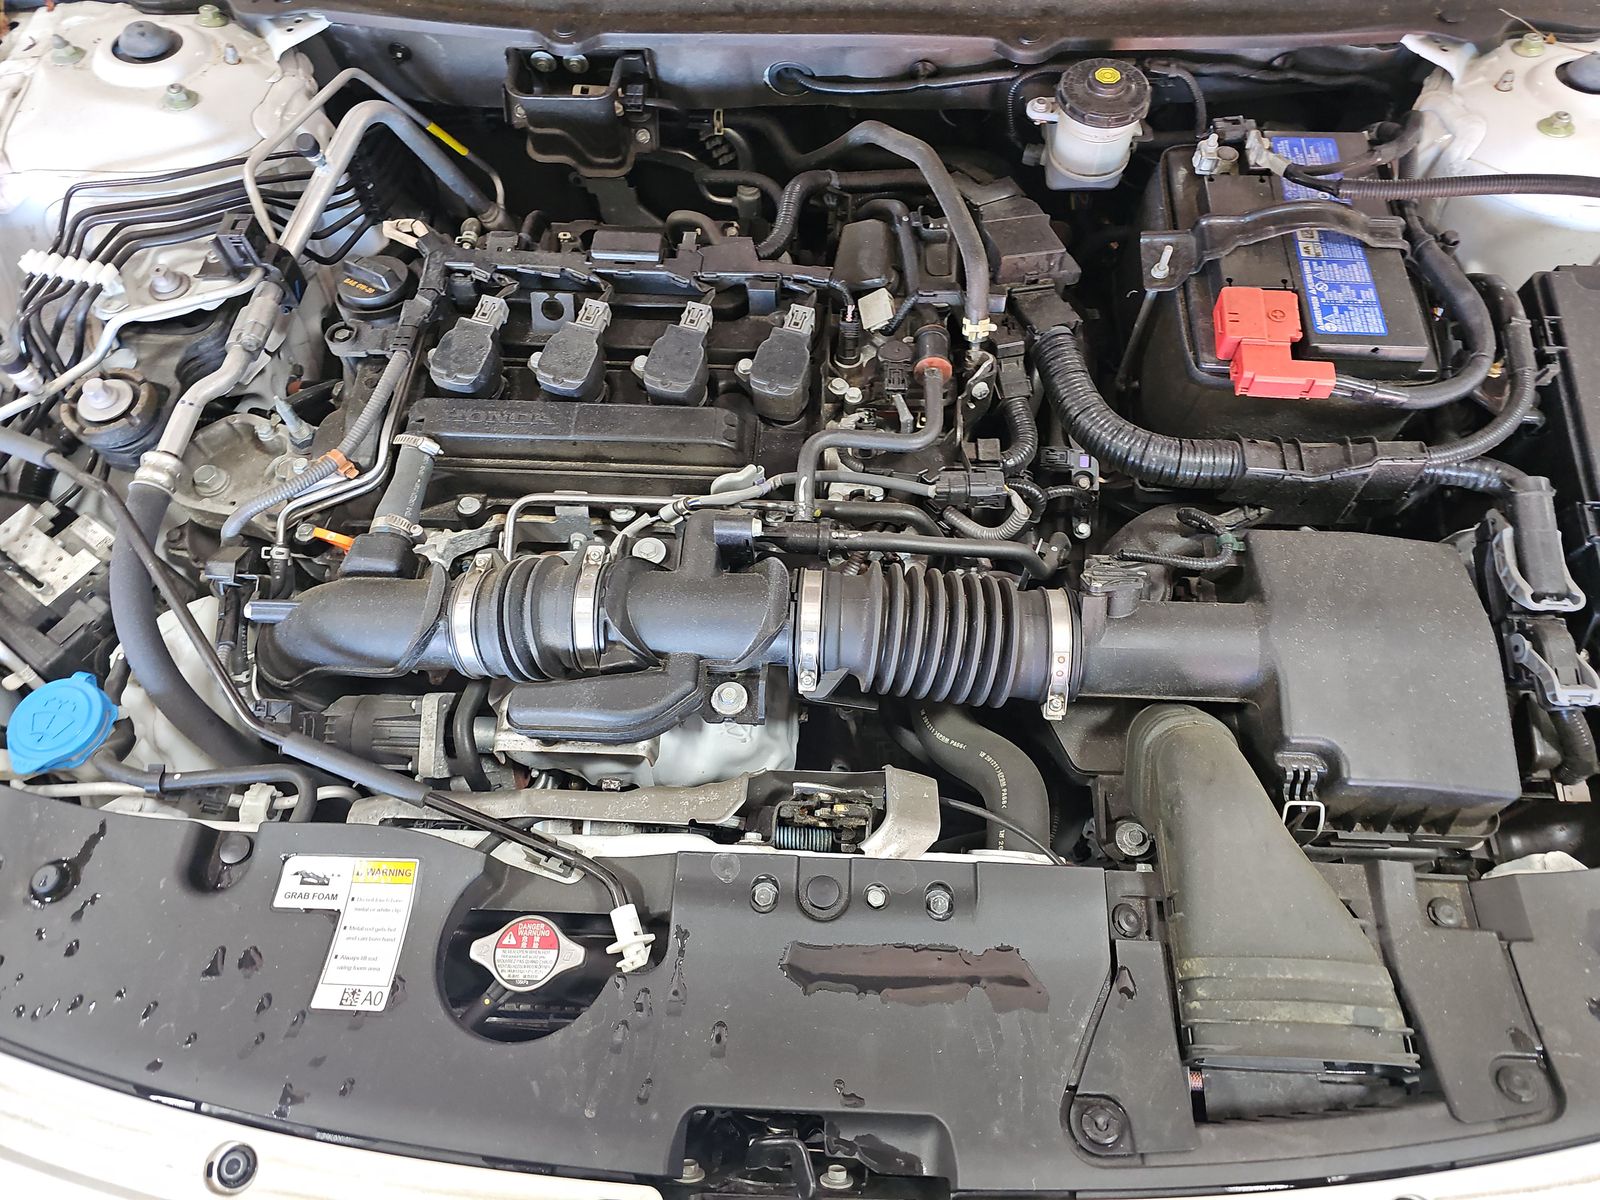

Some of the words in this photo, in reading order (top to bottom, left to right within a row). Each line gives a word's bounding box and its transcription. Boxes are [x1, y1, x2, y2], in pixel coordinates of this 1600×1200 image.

[444, 409, 556, 425] HONDA
[367, 868, 412, 877] WARNING
[284, 892, 310, 900] GRAB
[312, 893, 338, 901] FOAM
[361, 991, 384, 1006] A0
